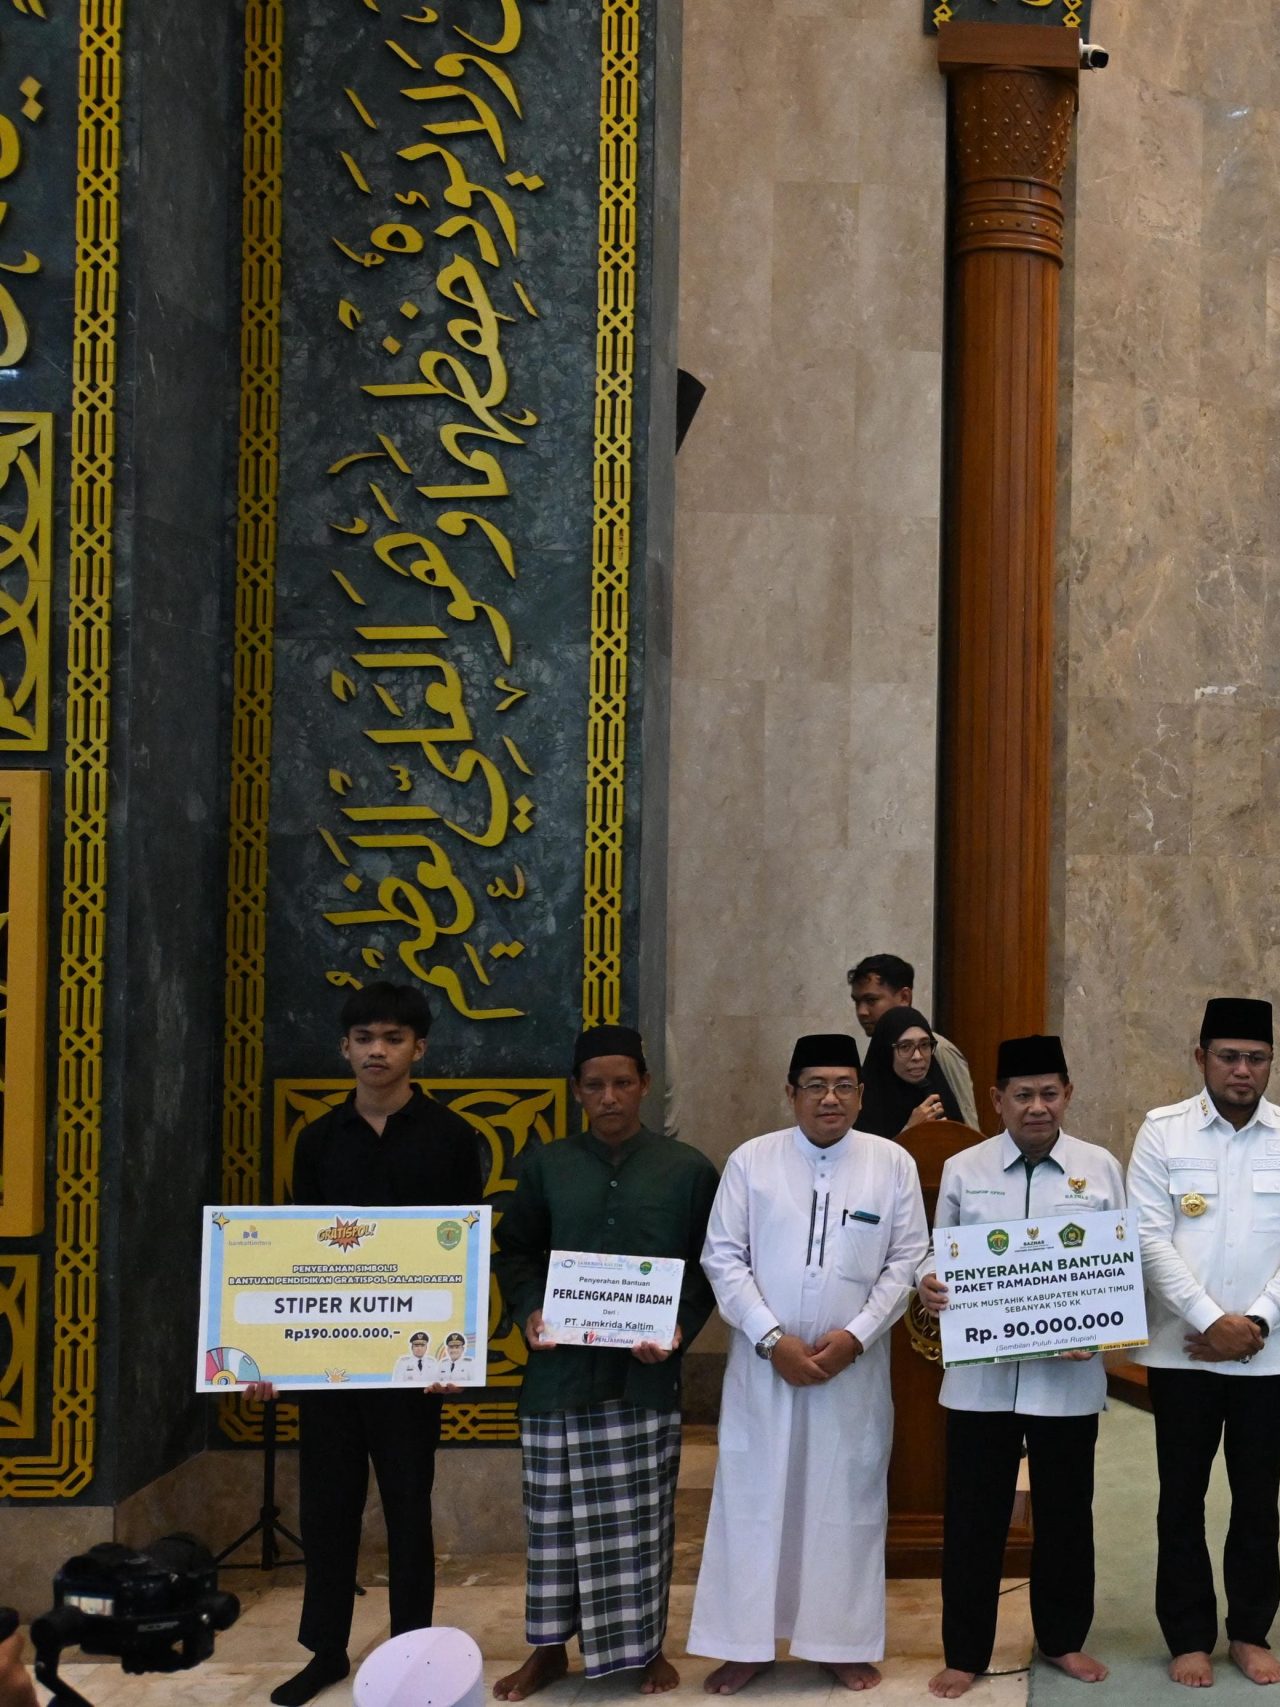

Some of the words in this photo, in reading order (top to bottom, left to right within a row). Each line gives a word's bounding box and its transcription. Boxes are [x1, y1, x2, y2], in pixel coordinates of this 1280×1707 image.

[317, 1223, 377, 1243] GRATISPOL!
[292, 1264, 354, 1273] PENYERAHAN
[356, 1264, 398, 1273] SIMBOLIS
[945, 1260, 1054, 1282] PENYERAHAN
[1057, 1252, 1134, 1270] BANTUAN
[228, 1277, 274, 1286] BANTUAN
[275, 1276, 333, 1285] PENDIDIKAN
[334, 1275, 387, 1285] GRATISPOL
[388, 1274, 423, 1284] DALAM
[424, 1274, 462, 1284] DAERAH
[579, 1277, 620, 1285] Penyerahan
[954, 1281, 996, 1294] PAKET
[999, 1273, 1068, 1290] RAMADHAN
[1071, 1268, 1125, 1281] BAHAGIA
[274, 1297, 342, 1314] STIPER
[350, 1296, 413, 1313] KUTIM
[553, 1288, 633, 1303] PERLENGKAPAN
[635, 1294, 673, 1305] IBADAH
[949, 1301, 978, 1311] UNTUK
[981, 1296, 1025, 1308] MUSTAHIK
[1027, 1291, 1078, 1303] KABUPATEN
[1080, 1288, 1106, 1297] KUTAI
[1108, 1284, 1134, 1294] TIMUR
[1005, 1303, 1051, 1314] SEBANYAK
[1053, 1301, 1068, 1309] 150
[1070, 1299, 1081, 1307] KK
[564, 1318, 578, 1326] PT.
[580, 1319, 623, 1329] Jamkrida
[625, 1321, 654, 1331] Kaltim
[965, 1327, 998, 1345] Rp.
[1003, 1311, 1124, 1339] 90.000.000
[284, 1328, 400, 1341] Rp190.000.000,-
[996, 1342, 1031, 1353] (Sembilan
[1032, 1340, 1052, 1349] Puluh
[1053, 1337, 1068, 1346] Juta
[1070, 1334, 1097, 1346] Rupiah)
